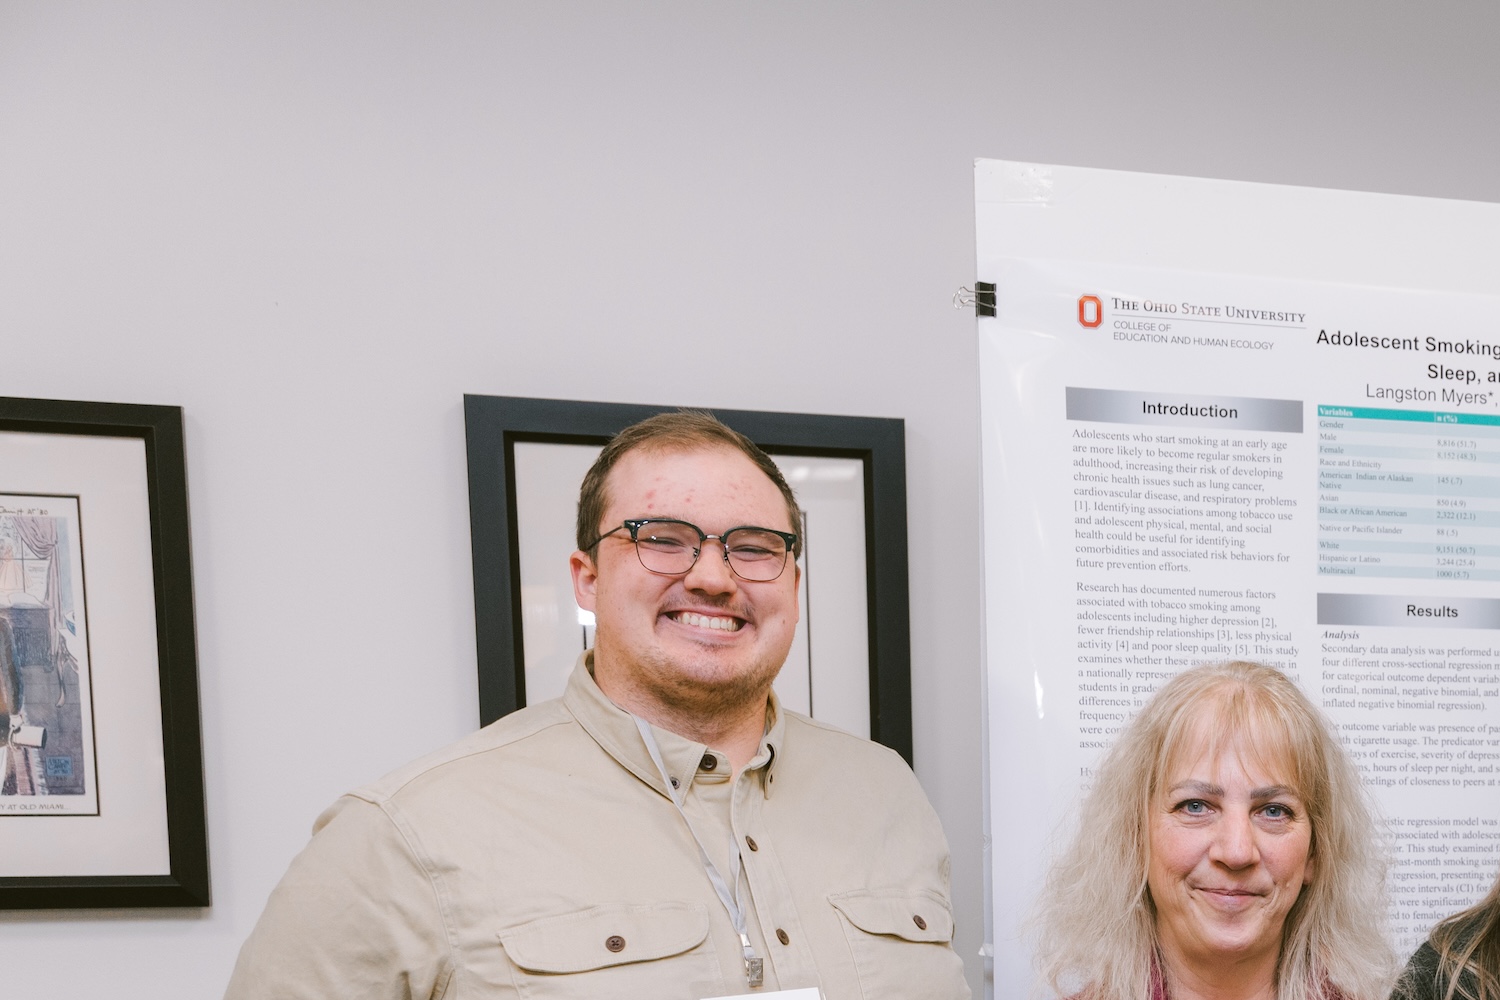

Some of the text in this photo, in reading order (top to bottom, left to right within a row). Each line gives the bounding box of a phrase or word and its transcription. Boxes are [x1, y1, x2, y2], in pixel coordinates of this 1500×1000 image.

[1112, 298, 1305, 322] THE OHIO STATE UNIVERSITY
[1114, 320, 1171, 331] COLLEGE OF
[1114, 332, 1274, 350] EDUCATION AND HUMAN ECOLOGY
[1317, 330, 1419, 350] Adolescent
[1428, 364, 1481, 385] Sleep,
[1367, 384, 1436, 403] Langston
[1143, 401, 1238, 419] Introduction
[1320, 407, 1353, 417] Variables
[1320, 420, 1344, 429] Gender
[1073, 429, 1129, 441] Adolescents
[1133, 434, 1153, 442] who
[1156, 435, 1175, 444] start
[1178, 436, 1218, 448] smoking
[1221, 438, 1229, 446] at
[1246, 439, 1269, 451] early
[1272, 442, 1287, 451] age
[1073, 445, 1087, 453] are
[1117, 444, 1142, 458] likely
[1147, 449, 1155, 457] to
[1158, 448, 1194, 459] become
[1197, 452, 1229, 463] regular
[1232, 452, 1270, 463] smokers
[1273, 454, 1282, 463] in
[1320, 446, 1344, 454] Female
[1073, 458, 1283, 480] adulthood, increasing their risk of developing
[1407, 605, 1458, 618] Results
[1321, 630, 1360, 640] Analysis
[1321, 644, 1367, 655] Secondary
[1370, 645, 1388, 655] data
[1391, 646, 1426, 658] analysis
[1447, 648, 1491, 659] performed
